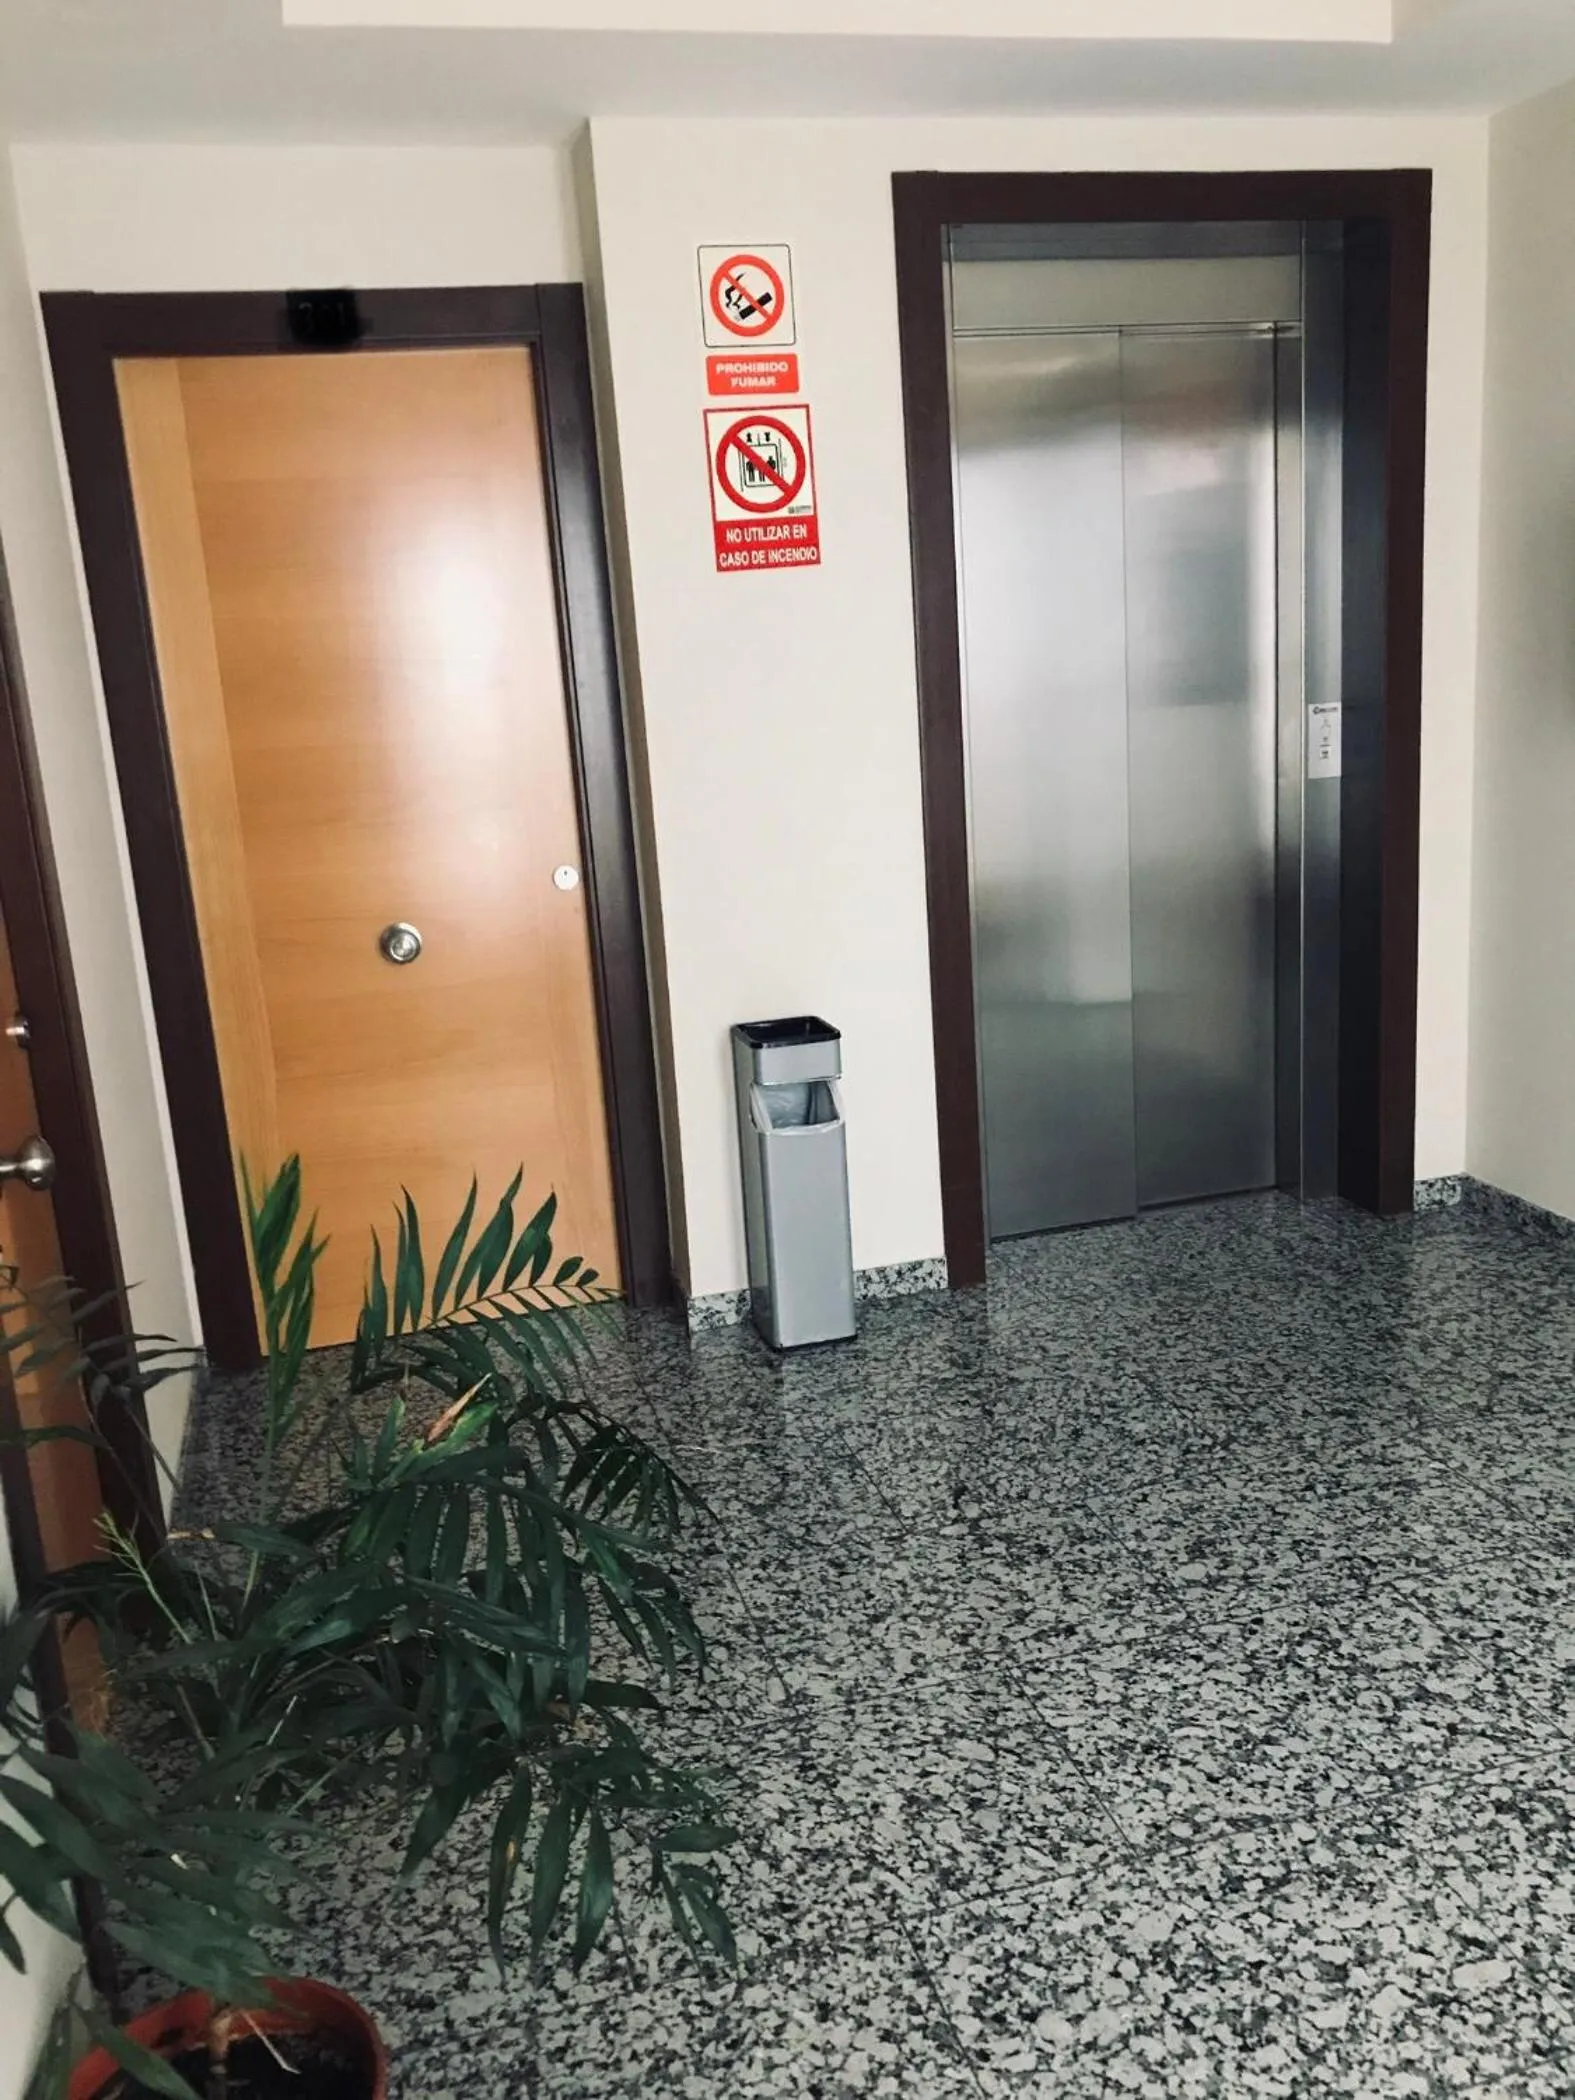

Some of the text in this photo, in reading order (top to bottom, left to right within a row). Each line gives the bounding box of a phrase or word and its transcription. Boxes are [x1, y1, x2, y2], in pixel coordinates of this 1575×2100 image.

[715, 361, 789, 374] PROHIBIDO
[730, 375, 776, 388] FUMAR
[726, 524, 807, 543] NO UTILIZAR EN
[719, 547, 817, 567] CASO DE INCENDIO
